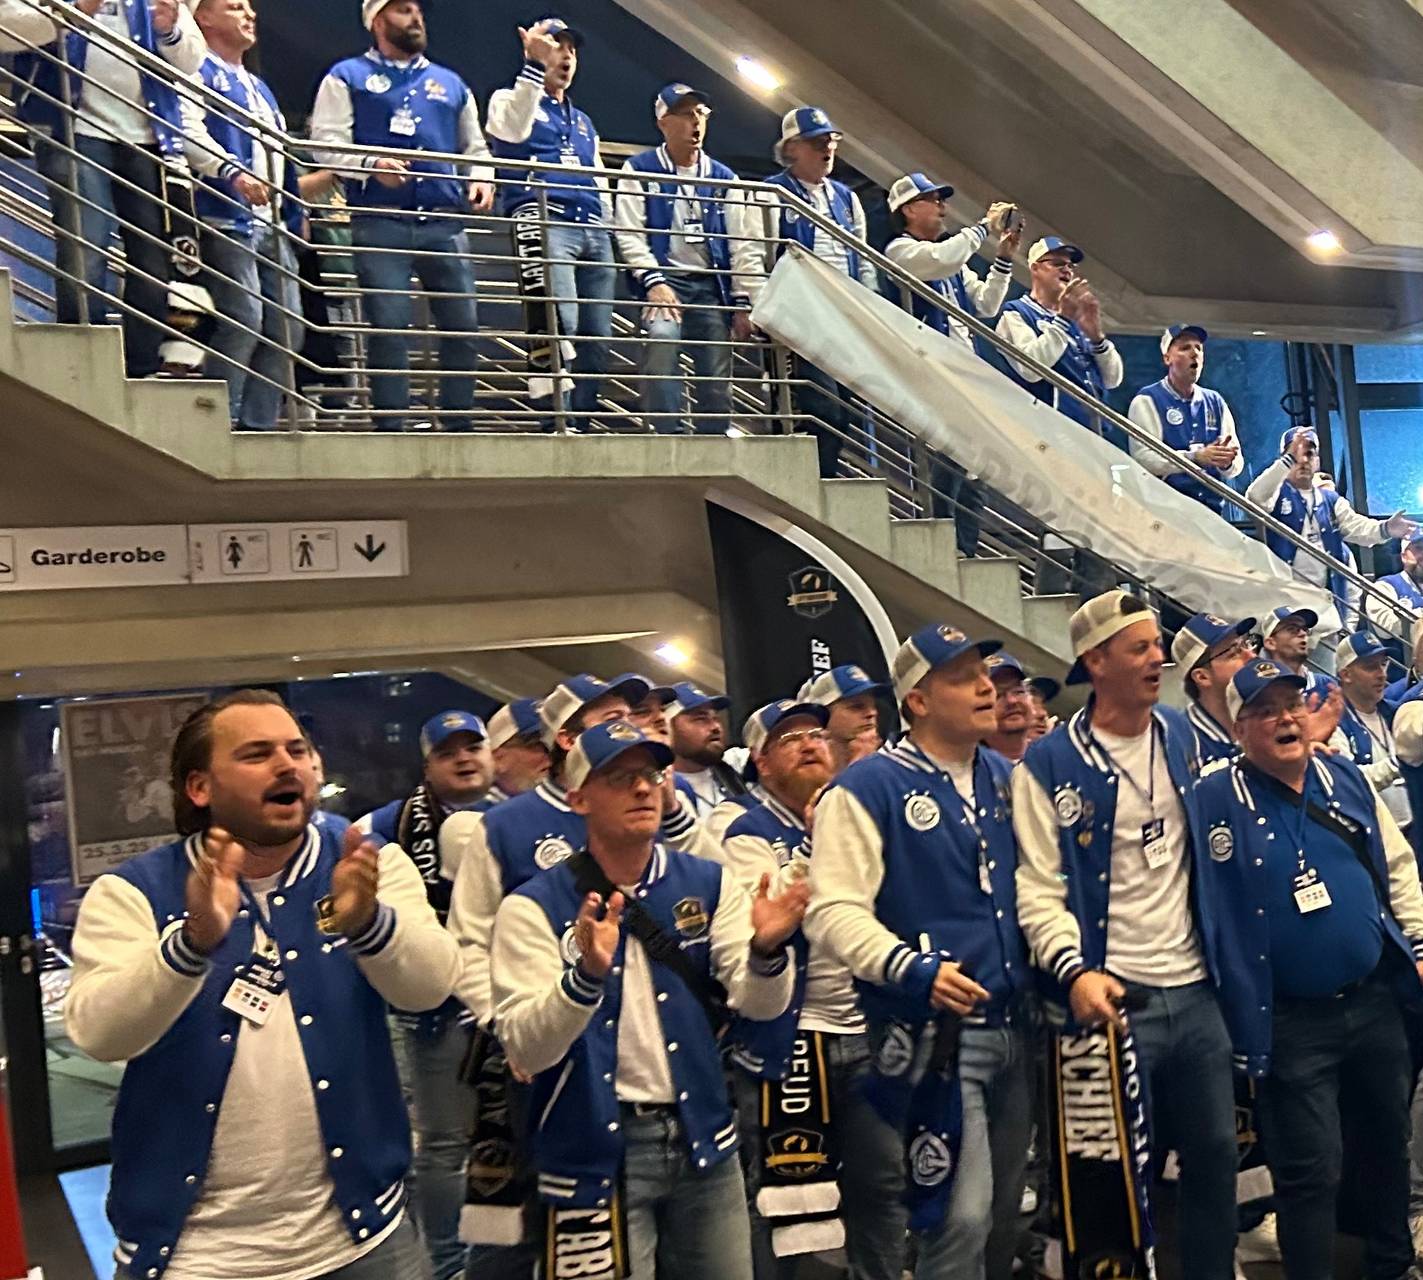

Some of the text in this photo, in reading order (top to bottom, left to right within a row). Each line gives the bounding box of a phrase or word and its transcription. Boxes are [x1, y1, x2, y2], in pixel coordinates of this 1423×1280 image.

[31, 547, 166, 567] Garderobe
[781, 1037, 811, 1114] REUD
[1060, 1033, 1121, 1162] SCHIEF
